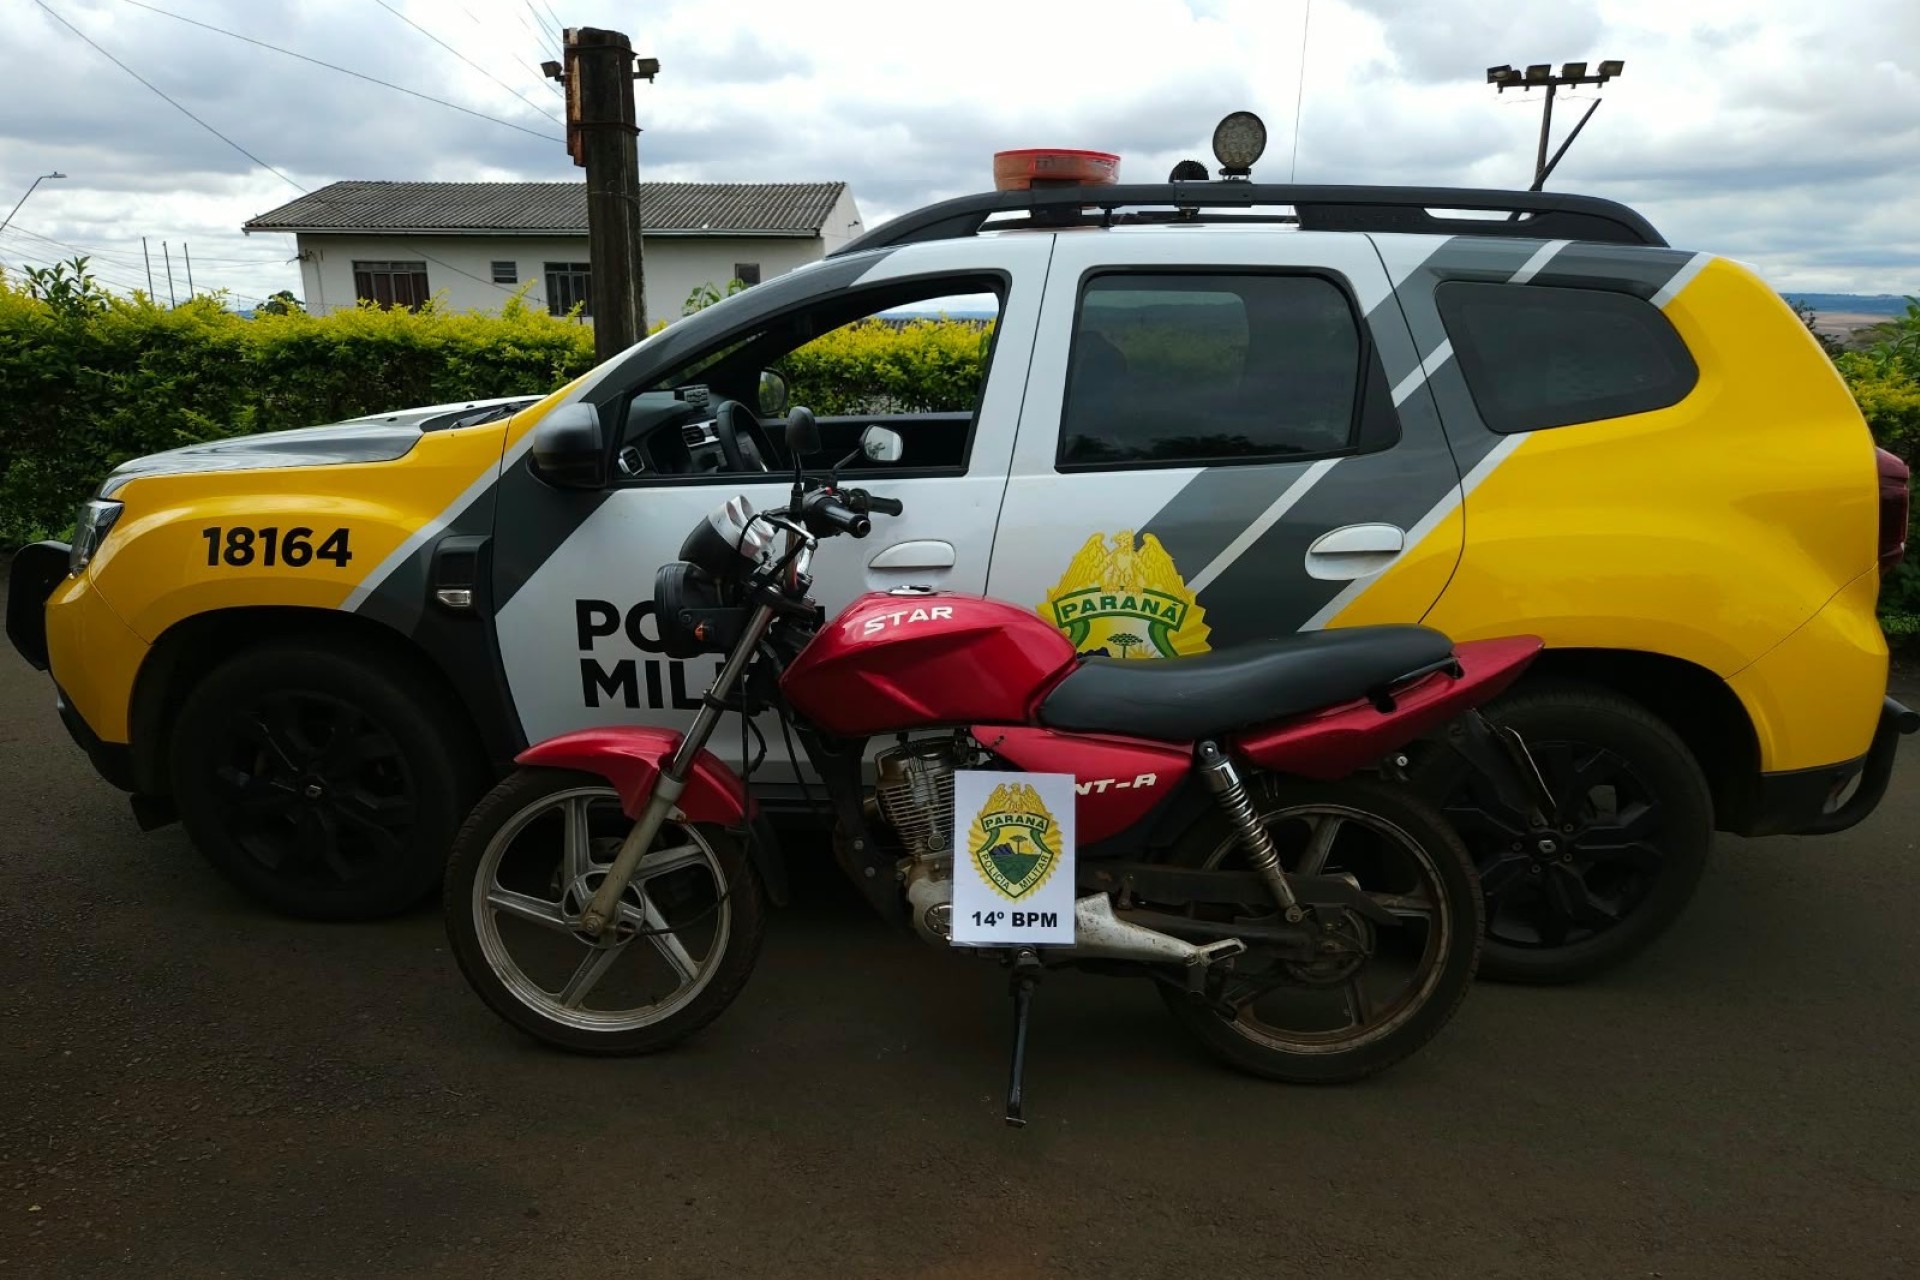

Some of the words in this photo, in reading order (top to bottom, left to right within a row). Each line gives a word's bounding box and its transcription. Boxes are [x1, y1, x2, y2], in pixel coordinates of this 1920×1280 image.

[203, 526, 353, 567] 18164
[864, 606, 953, 635] STAR
[1060, 594, 1177, 623] PARANÁ
[1075, 772, 1157, 796] NT-A
[1019, 854, 1049, 889] MILITAR
[1011, 911, 1058, 928] BPM
